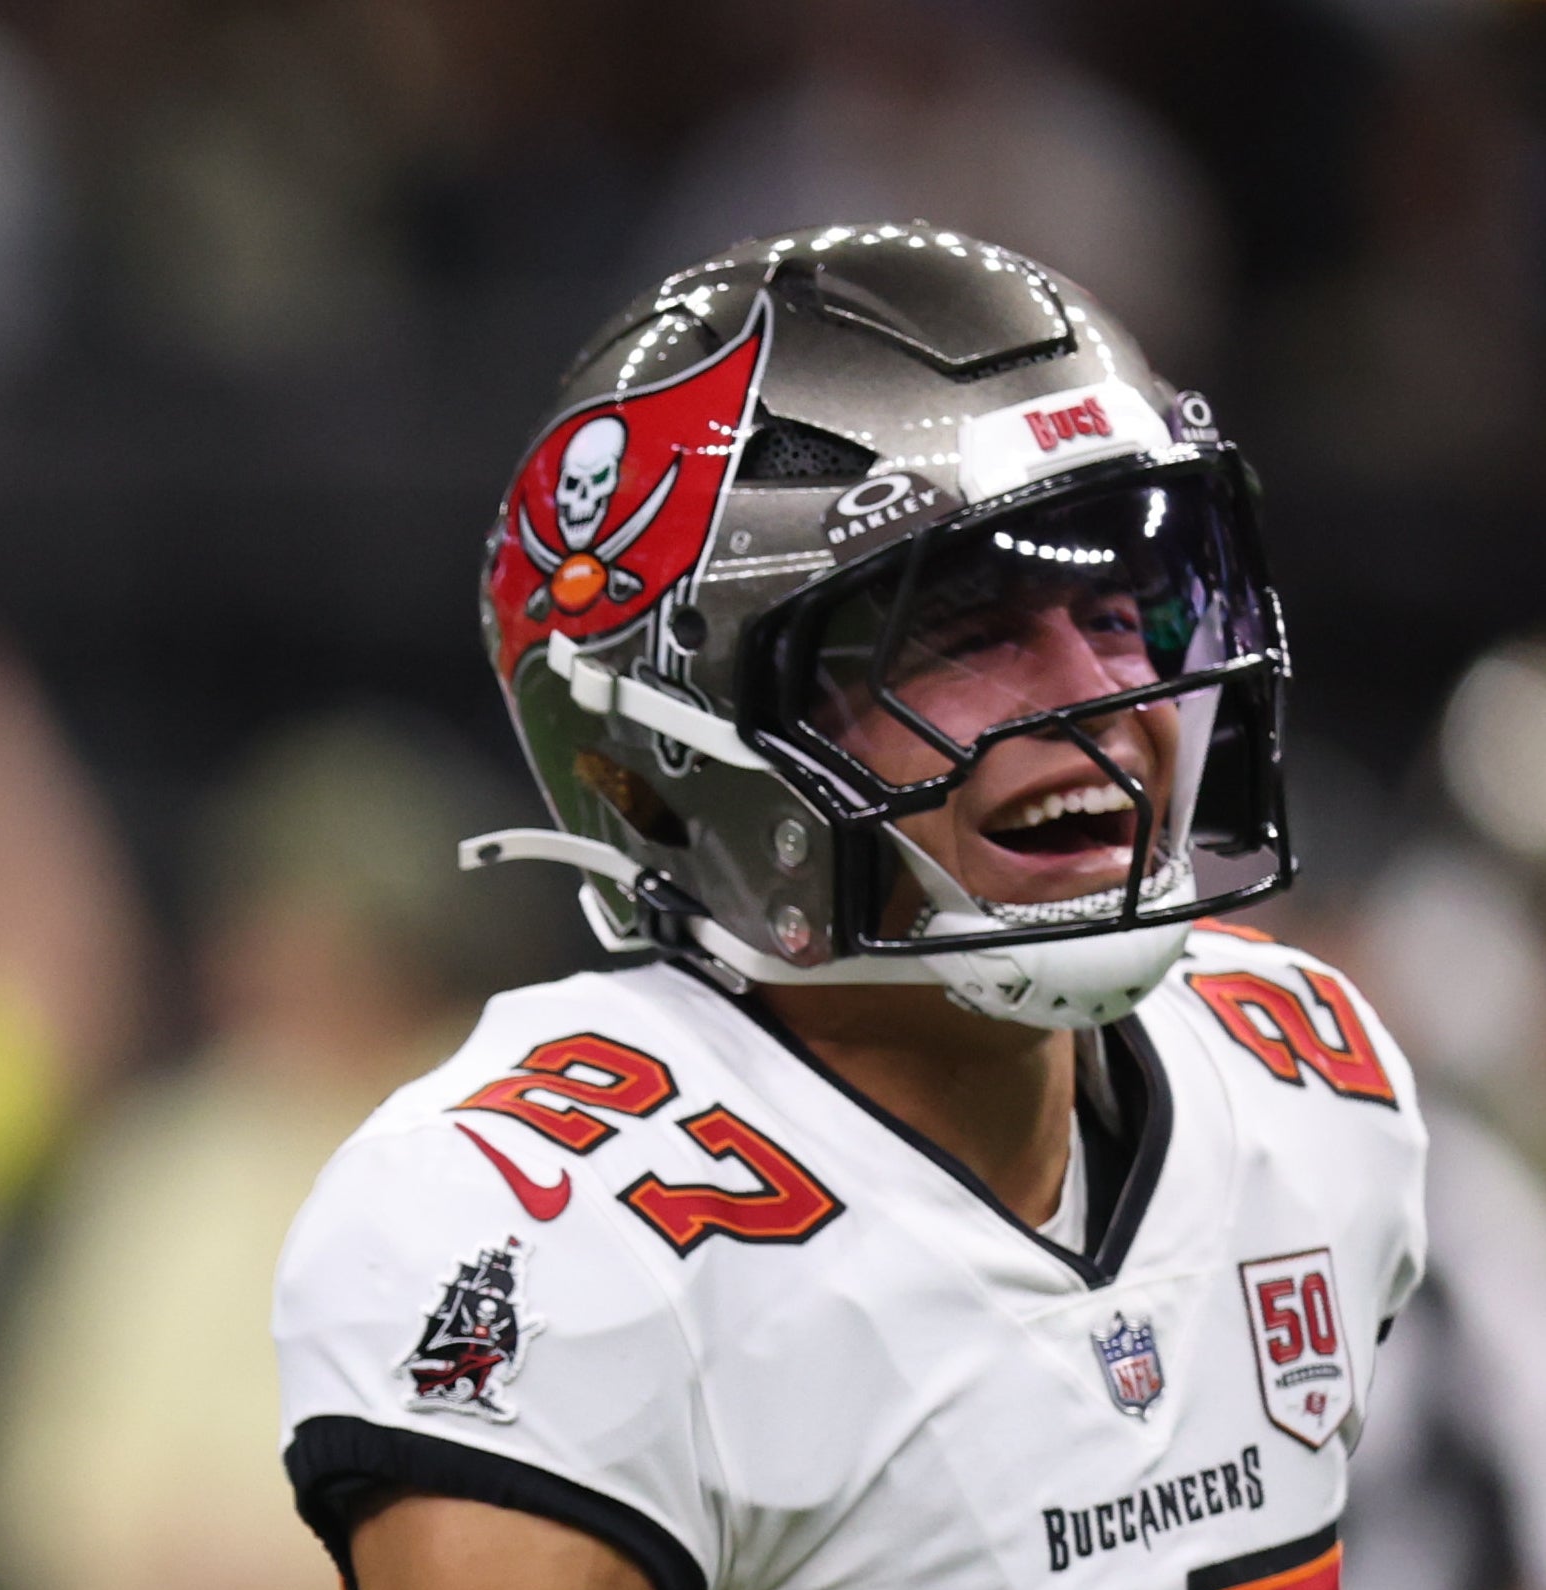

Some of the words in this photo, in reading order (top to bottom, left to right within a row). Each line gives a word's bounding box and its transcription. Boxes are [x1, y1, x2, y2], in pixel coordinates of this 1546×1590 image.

[1024, 396, 1112, 451] BUCS
[828, 489, 935, 544] OAKLEY
[1184, 917, 1399, 1112] 2
[443, 1032, 846, 1259] 27
[1256, 1272, 1338, 1365] 50
[1115, 1357, 1162, 1401] NFL
[1042, 1444, 1265, 1571] BUCCANEERS
